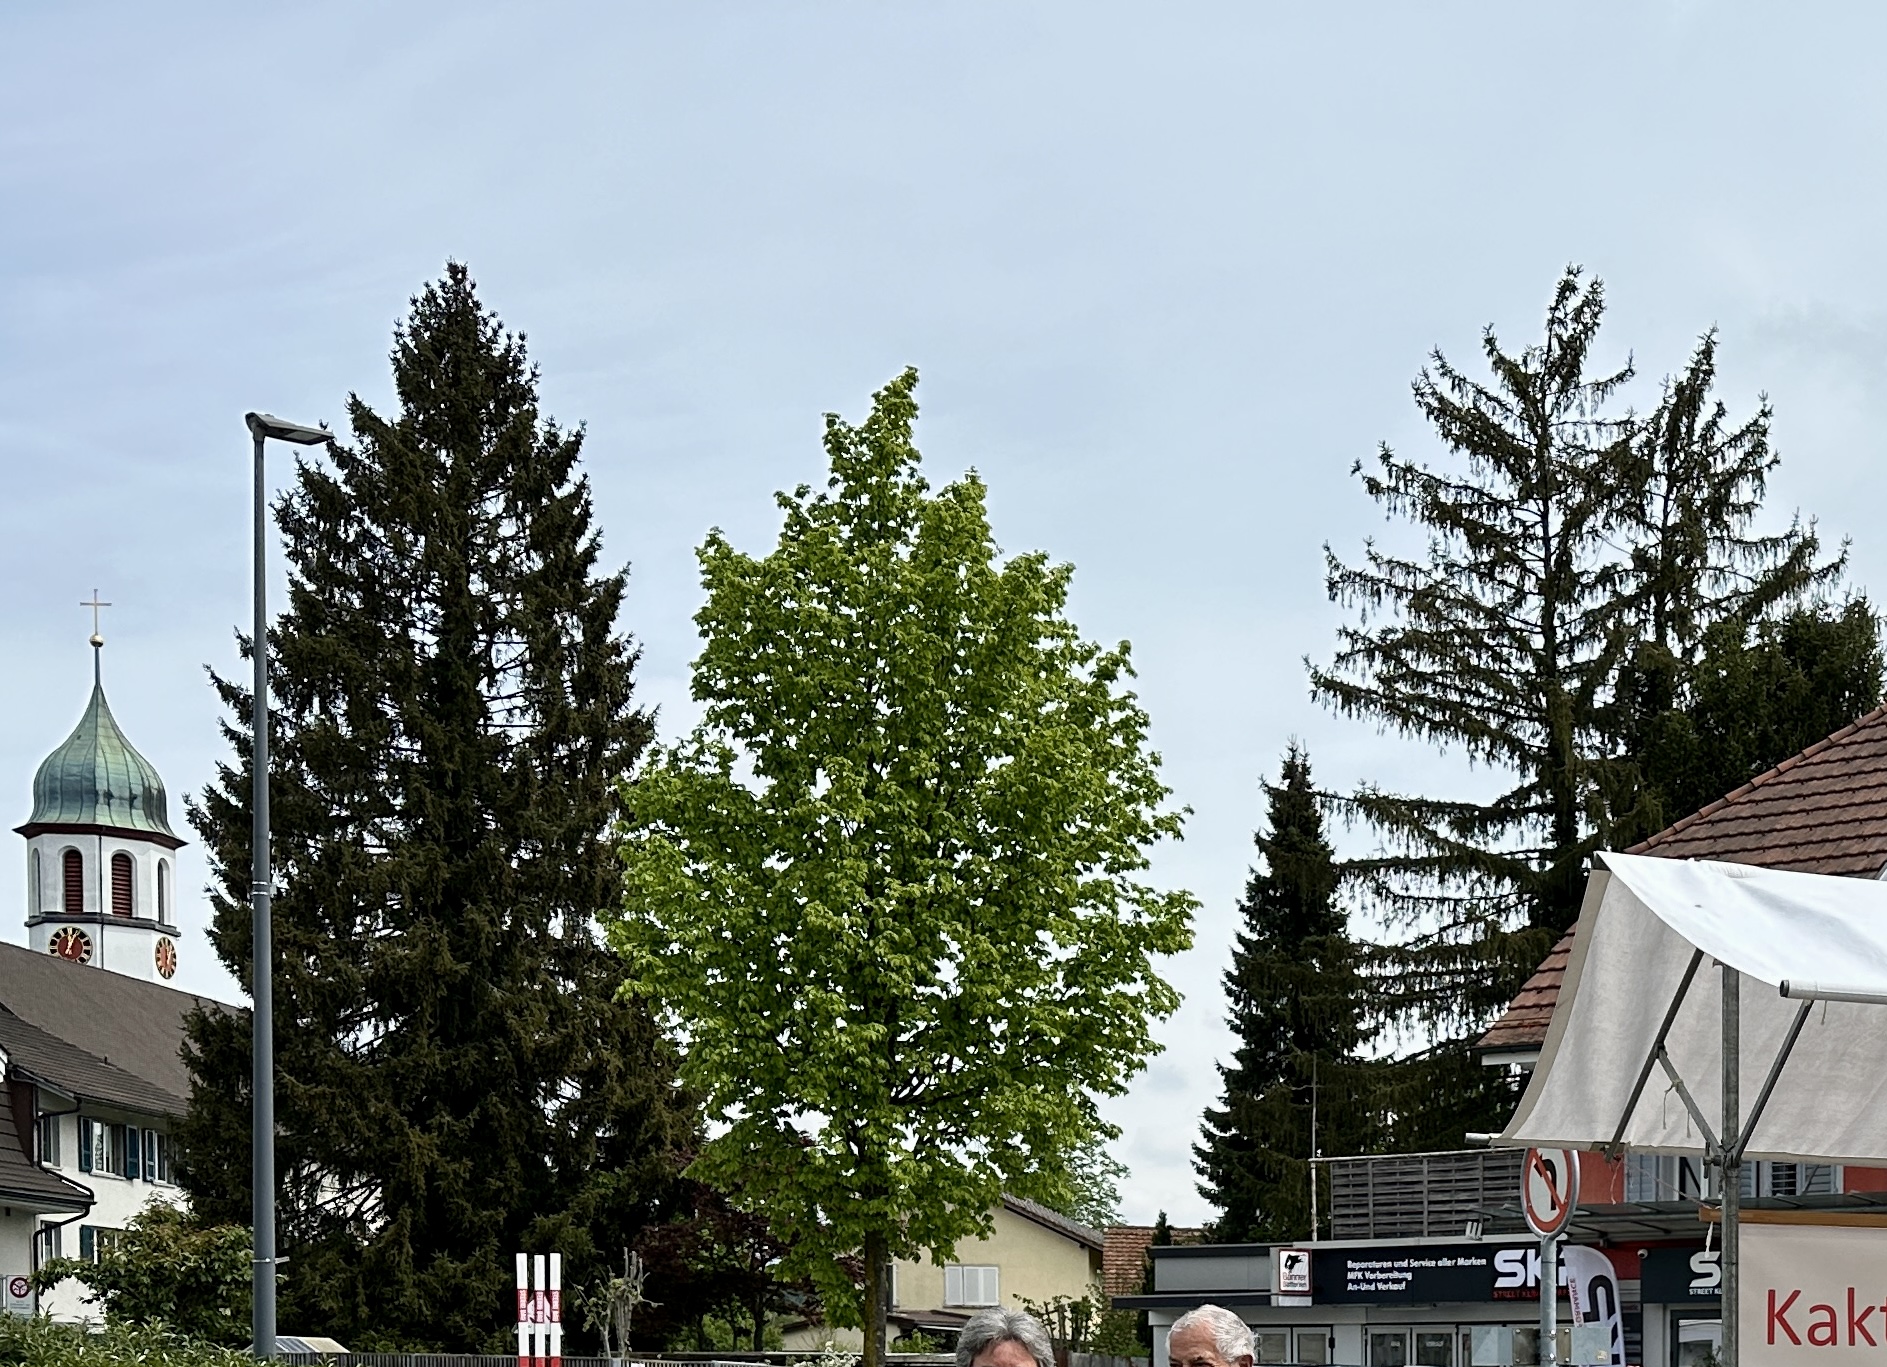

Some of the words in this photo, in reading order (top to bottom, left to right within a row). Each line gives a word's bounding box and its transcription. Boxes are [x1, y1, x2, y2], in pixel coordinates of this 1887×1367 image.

[1347, 1260, 1393, 1270] Reparaturen
[1393, 1259, 1409, 1268] und
[1409, 1258, 1436, 1268] Service
[1437, 1257, 1457, 1267] aller
[1457, 1256, 1487, 1266] Marken
[1364, 1270, 1413, 1281] Vorbereitung
[1376, 1281, 1407, 1291] Verkauf
